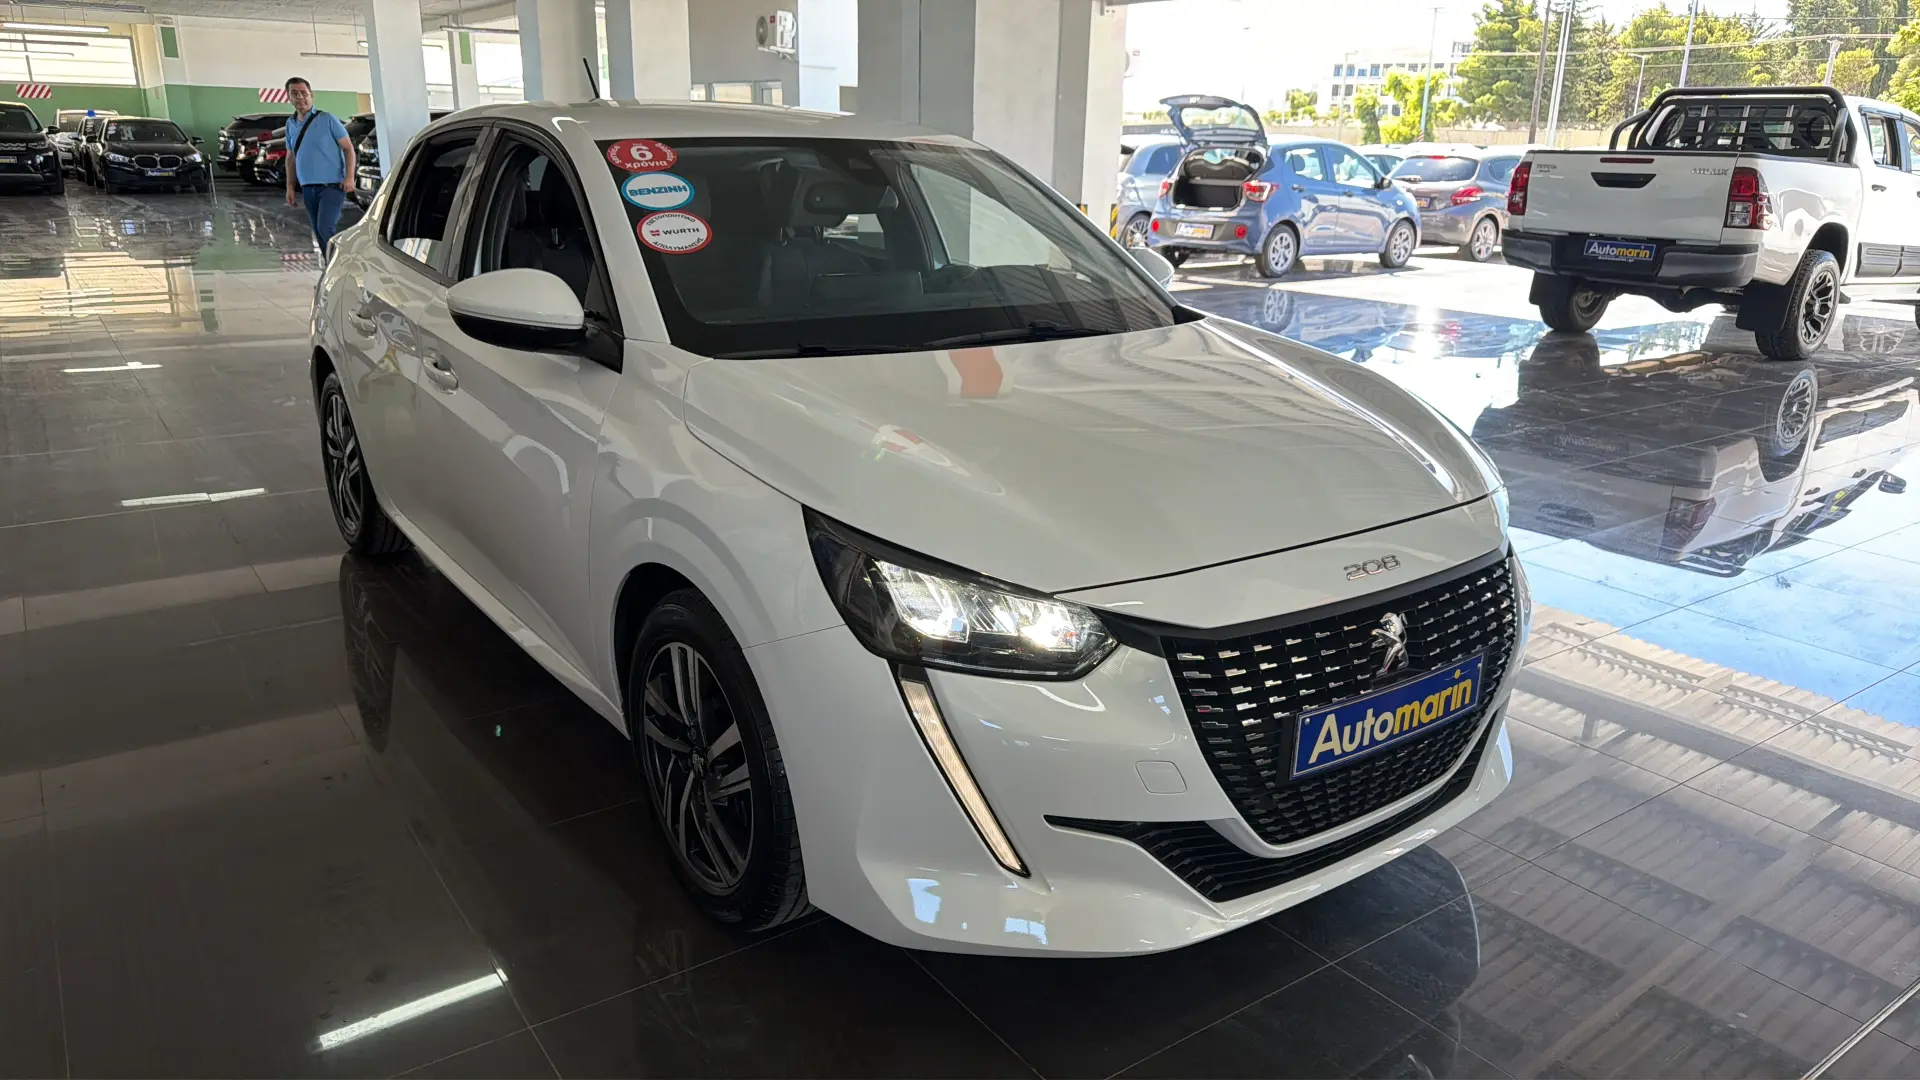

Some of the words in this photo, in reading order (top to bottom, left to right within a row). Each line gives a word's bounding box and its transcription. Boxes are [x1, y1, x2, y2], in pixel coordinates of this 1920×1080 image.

[630, 145, 653, 161] 6
[625, 161, 668, 170] χρόνια
[628, 185, 688, 197] ΒΕΝΖΙΝΗ
[1588, 242, 1650, 259] Automarin
[1343, 554, 1401, 582] 208
[1308, 668, 1472, 765] Automarin
